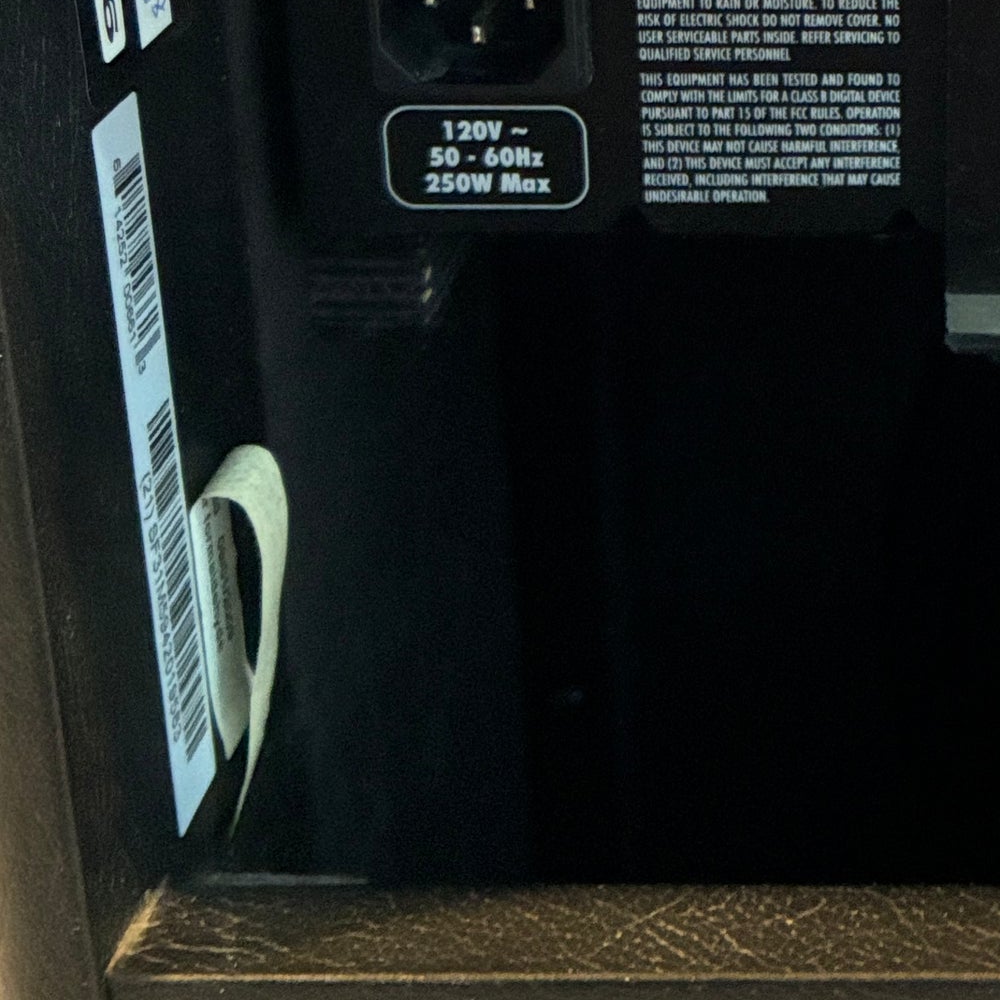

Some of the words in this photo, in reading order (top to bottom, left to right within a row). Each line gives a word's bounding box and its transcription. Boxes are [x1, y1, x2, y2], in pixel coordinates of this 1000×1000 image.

[637, 13, 660, 27] RISK
[663, 13, 676, 27] OF
[679, 13, 722, 27] ELECTRIC
[726, 13, 759, 27] SHOCK
[762, 14, 778, 27] DO
[780, 14, 801, 27] NOT
[803, 14, 843, 27] REMOVE
[884, 14, 900, 27] NO
[638, 31, 664, 44] USER
[666, 31, 728, 44] SERVICEABLE
[731, 31, 760, 44] PARTS
[801, 31, 831, 44] REFER
[834, 31, 884, 44] SERVICING
[888, 31, 901, 44] TO
[638, 47, 690, 61] QUALIFIED
[693, 47, 731, 61] SERVICE
[734, 47, 791, 61] PERSONNEL
[639, 72, 662, 86] THIS
[666, 72, 725, 86] EQUIPMENT
[728, 73, 749, 86] HAS
[752, 73, 779, 87] BEEN
[783, 73, 818, 87] TESTED
[821, 73, 844, 87] AND
[847, 73, 883, 87] FOUND
[887, 73, 901, 87] TO
[641, 107, 693, 120] PURSUANT
[696, 107, 709, 120] TO
[711, 107, 735, 120] PART
[739, 107, 751, 120] 15
[753, 107, 766, 120] OF
[770, 107, 787, 120] THE
[790, 107, 807, 120] FCC
[846, 107, 901, 120] OPERATION
[442, 120, 503, 141] 120V
[641, 123, 651, 137] IS
[654, 123, 695, 137] SUBJECT
[698, 123, 711, 137] TO
[714, 123, 731, 137] THE
[734, 123, 792, 137] FOLLOWING
[795, 123, 817, 137] TWO
[885, 123, 901, 137] (1)
[642, 140, 664, 153] THIS
[667, 140, 700, 153] DEVICE
[702, 140, 723, 153] MAY
[725, 140, 745, 153] NOT
[748, 140, 778, 154] CAUSE
[781, 140, 826, 154] HARMFUL
[430, 147, 460, 167] 50
[484, 147, 544, 167] 60Hz
[642, 157, 665, 171] AND
[667, 157, 683, 171] (2)
[685, 157, 706, 171] THIS
[709, 157, 742, 171] DEVICE
[744, 157, 771, 171] MUST
[773, 157, 808, 171] ACCEPT
[810, 157, 830, 171] ANY
[832, 157, 901, 171] INTERFERENCE
[425, 173, 493, 194] 250W
[501, 173, 551, 194] Max
[694, 173, 748, 186] INCLUDING
[751, 173, 819, 186] INTERFERENCE
[822, 173, 845, 186] THAT
[847, 173, 867, 186] MAY
[870, 173, 901, 186] CAUSE
[644, 190, 710, 203] UNDESIRABLE
